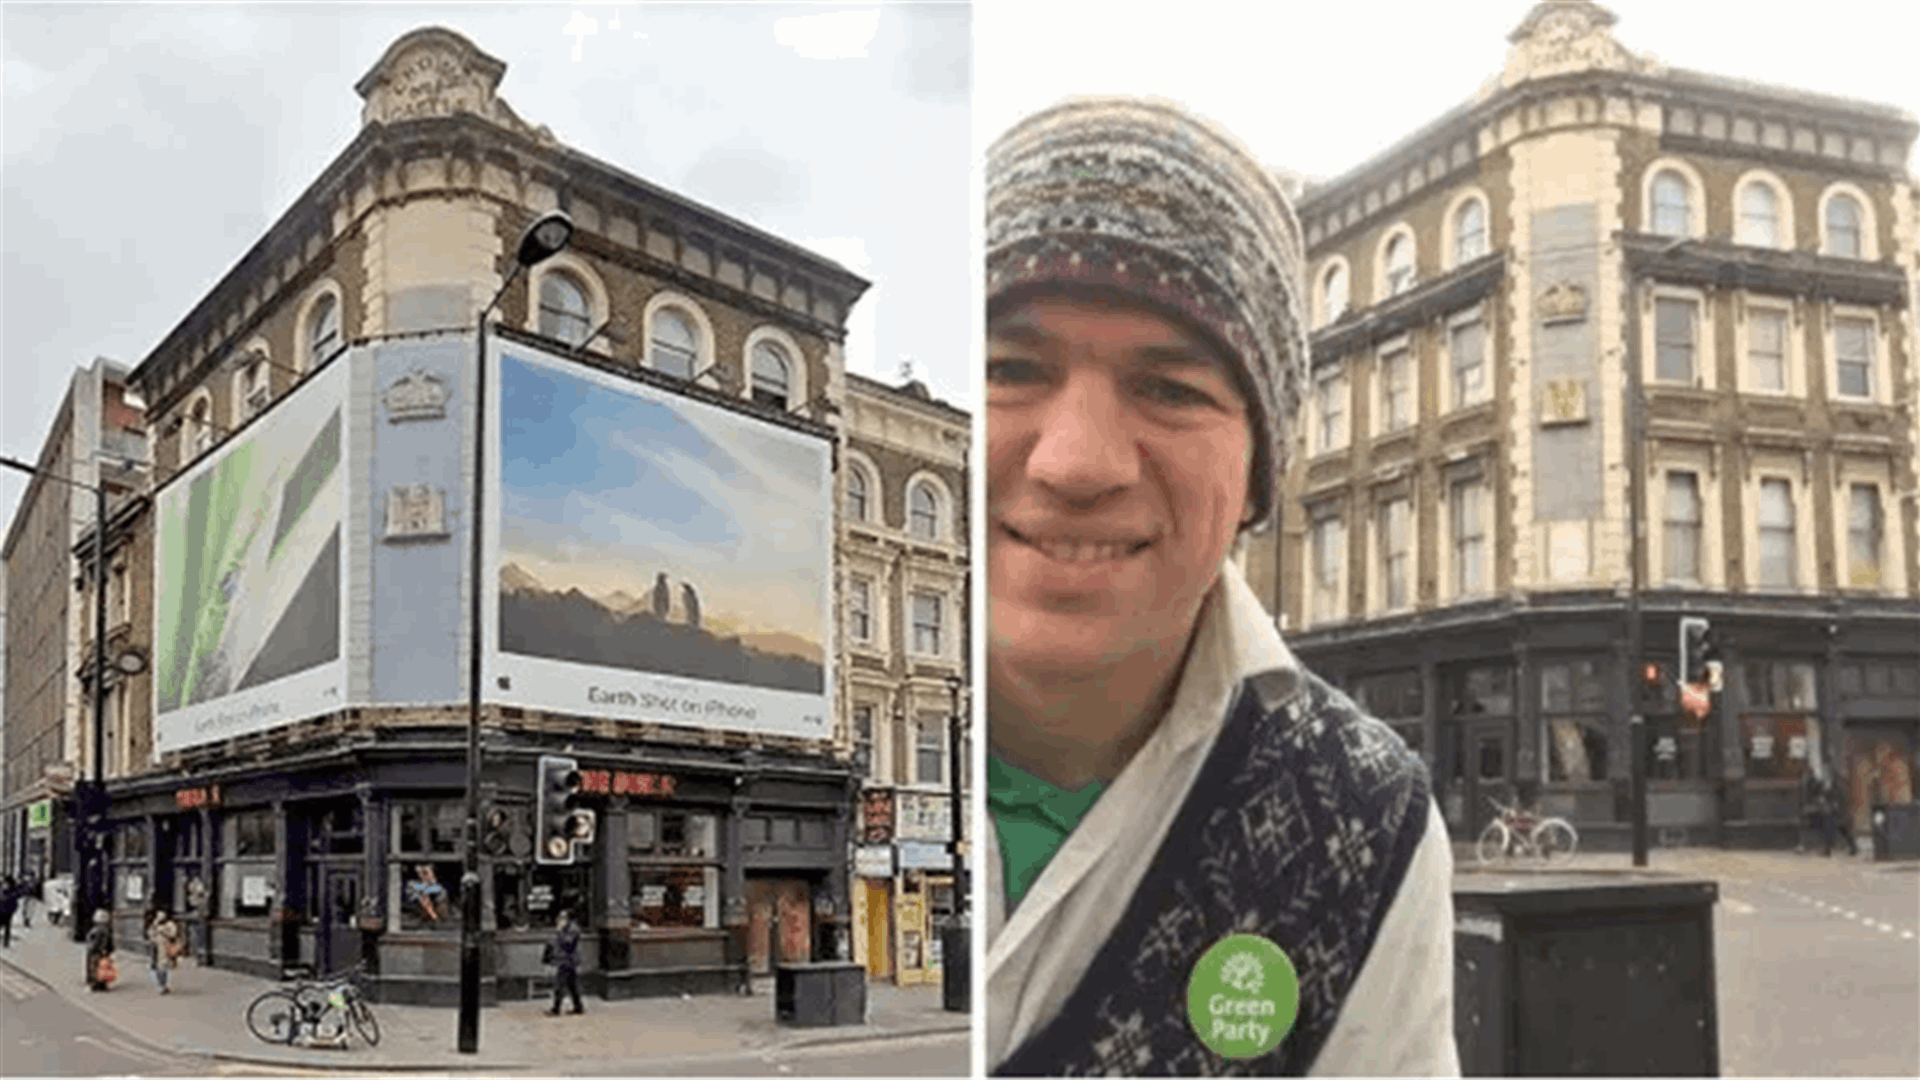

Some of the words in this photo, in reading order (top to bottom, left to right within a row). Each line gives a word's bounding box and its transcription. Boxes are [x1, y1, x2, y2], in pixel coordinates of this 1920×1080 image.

[588, 685, 637, 706] Earth
[1208, 993, 1276, 1016] Green
[1211, 1018, 1272, 1048] Party
